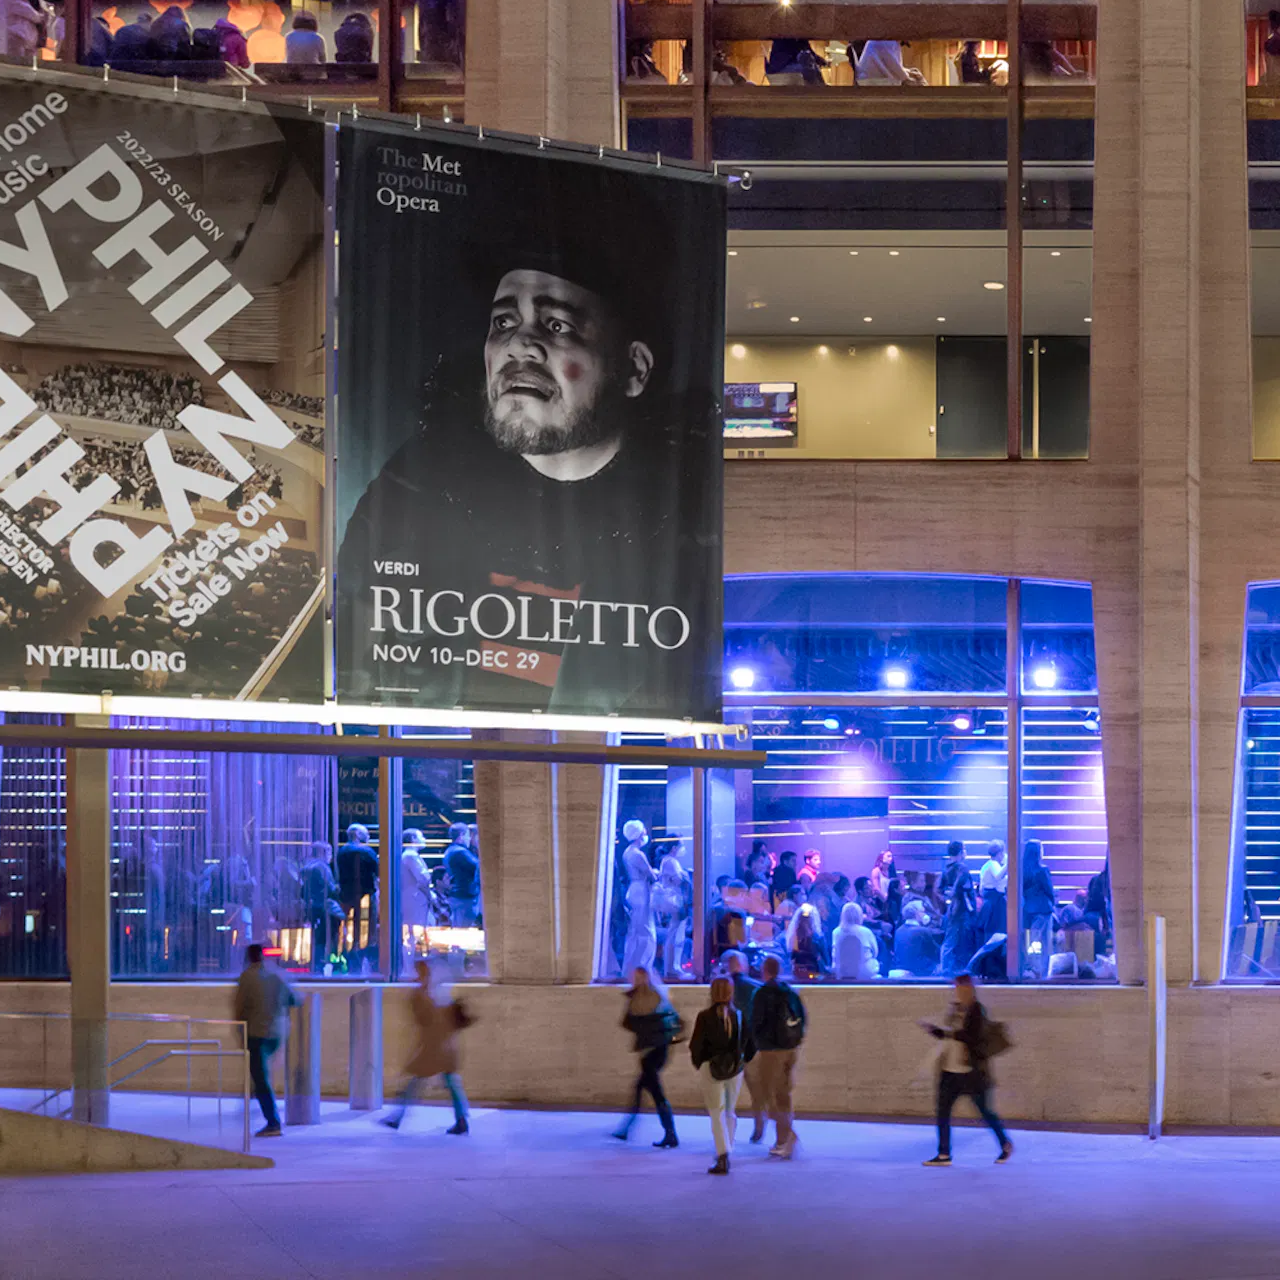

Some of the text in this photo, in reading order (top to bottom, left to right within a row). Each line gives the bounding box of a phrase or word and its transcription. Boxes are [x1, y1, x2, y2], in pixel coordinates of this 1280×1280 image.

[376, 146, 462, 176] The Met
[116, 130, 225, 241] 2022/23 SEASON
[377, 171, 468, 196] ropolitan
[376, 187, 440, 214] Opera
[140, 491, 277, 602] Tickets on
[169, 520, 290, 627] Sale Now
[373, 560, 420, 577] VERDI
[370, 585, 690, 650] RIGOLETTO
[25, 644, 187, 673] NYPHIL.ORG
[372, 644, 421, 663] NOV
[516, 652, 540, 670] 29
